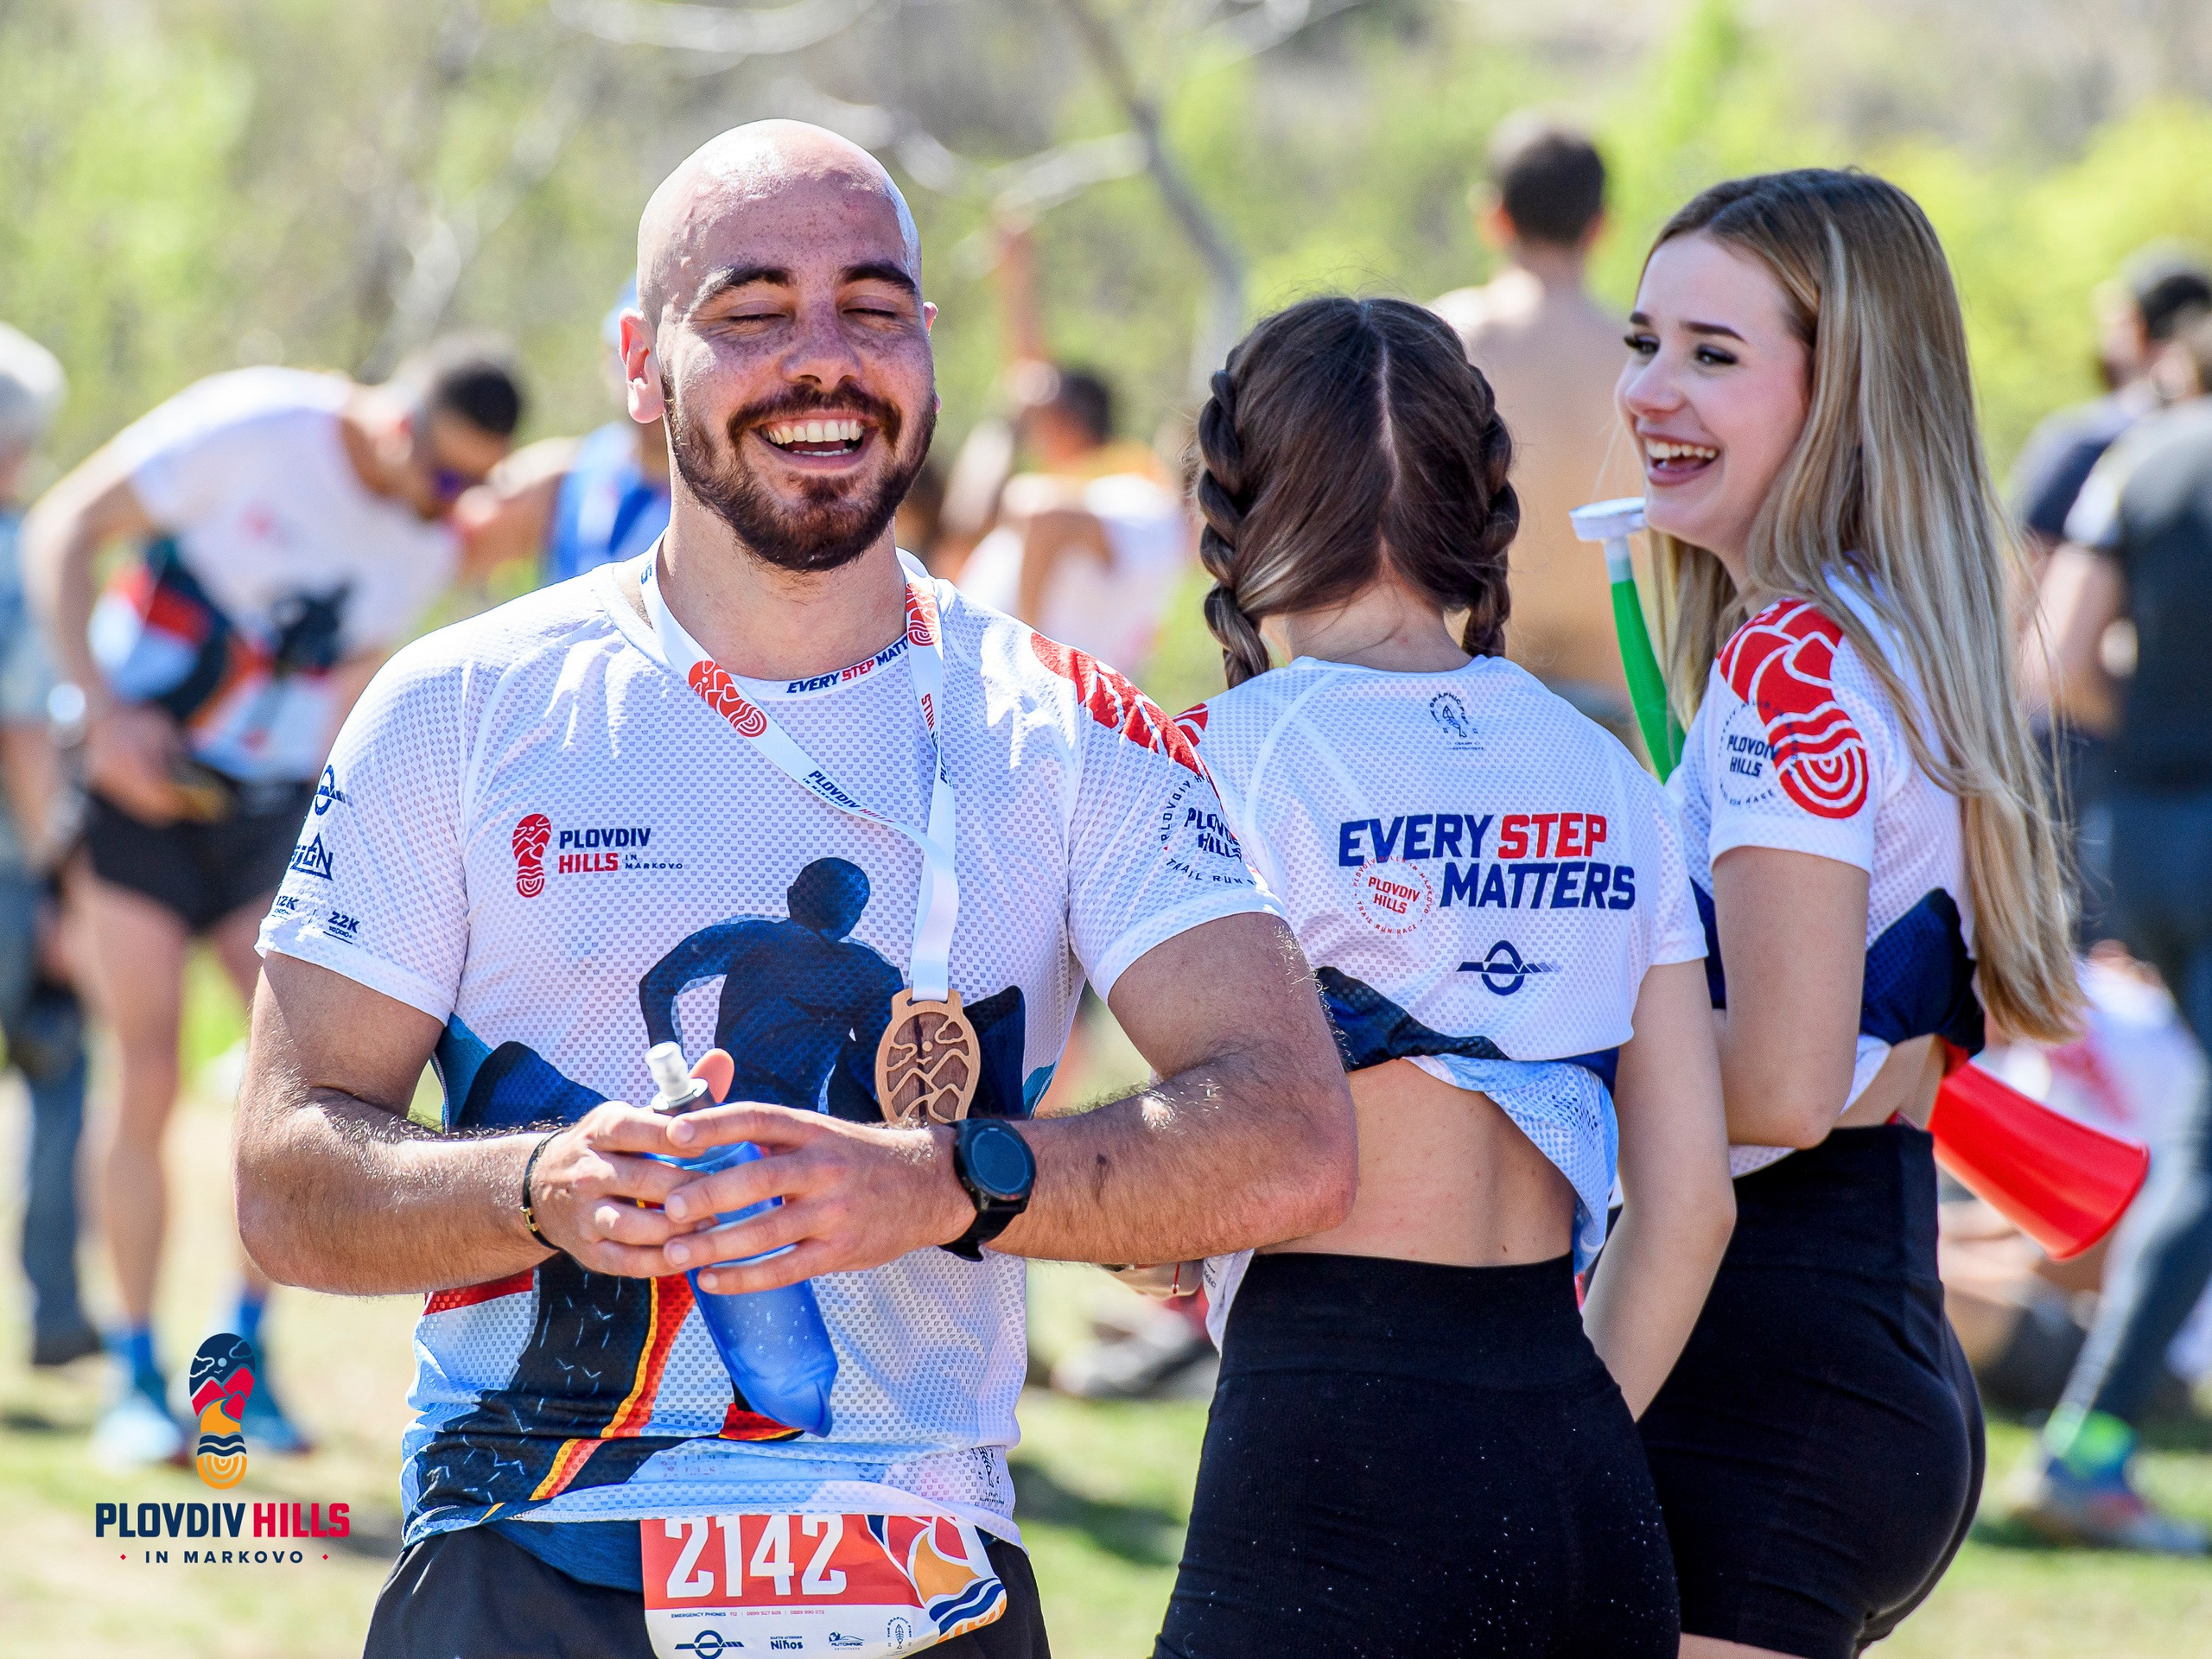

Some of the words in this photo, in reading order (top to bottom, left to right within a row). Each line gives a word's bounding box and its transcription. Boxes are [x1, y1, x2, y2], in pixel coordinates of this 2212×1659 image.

[786, 671, 840, 694] EVERY
[842, 658, 874, 682] STEP
[875, 635, 908, 666] MATT
[1729, 756, 1763, 778] HILLS
[809, 770, 861, 809] PLOVDIV
[1160, 779, 1192, 845] PLOVDIV
[559, 828, 652, 849] PLOVDIV
[1338, 813, 1494, 867] EVERY
[1497, 813, 1607, 859] STEP
[558, 852, 619, 874] HILLS
[1166, 858, 1203, 880] TRAIL
[1368, 875, 1421, 902] PLOVDIV
[1440, 861, 1635, 910] MATTERS
[1372, 893, 1408, 915] HILLS
[328, 910, 360, 934] 22K
[664, 1514, 848, 1599] 2142
